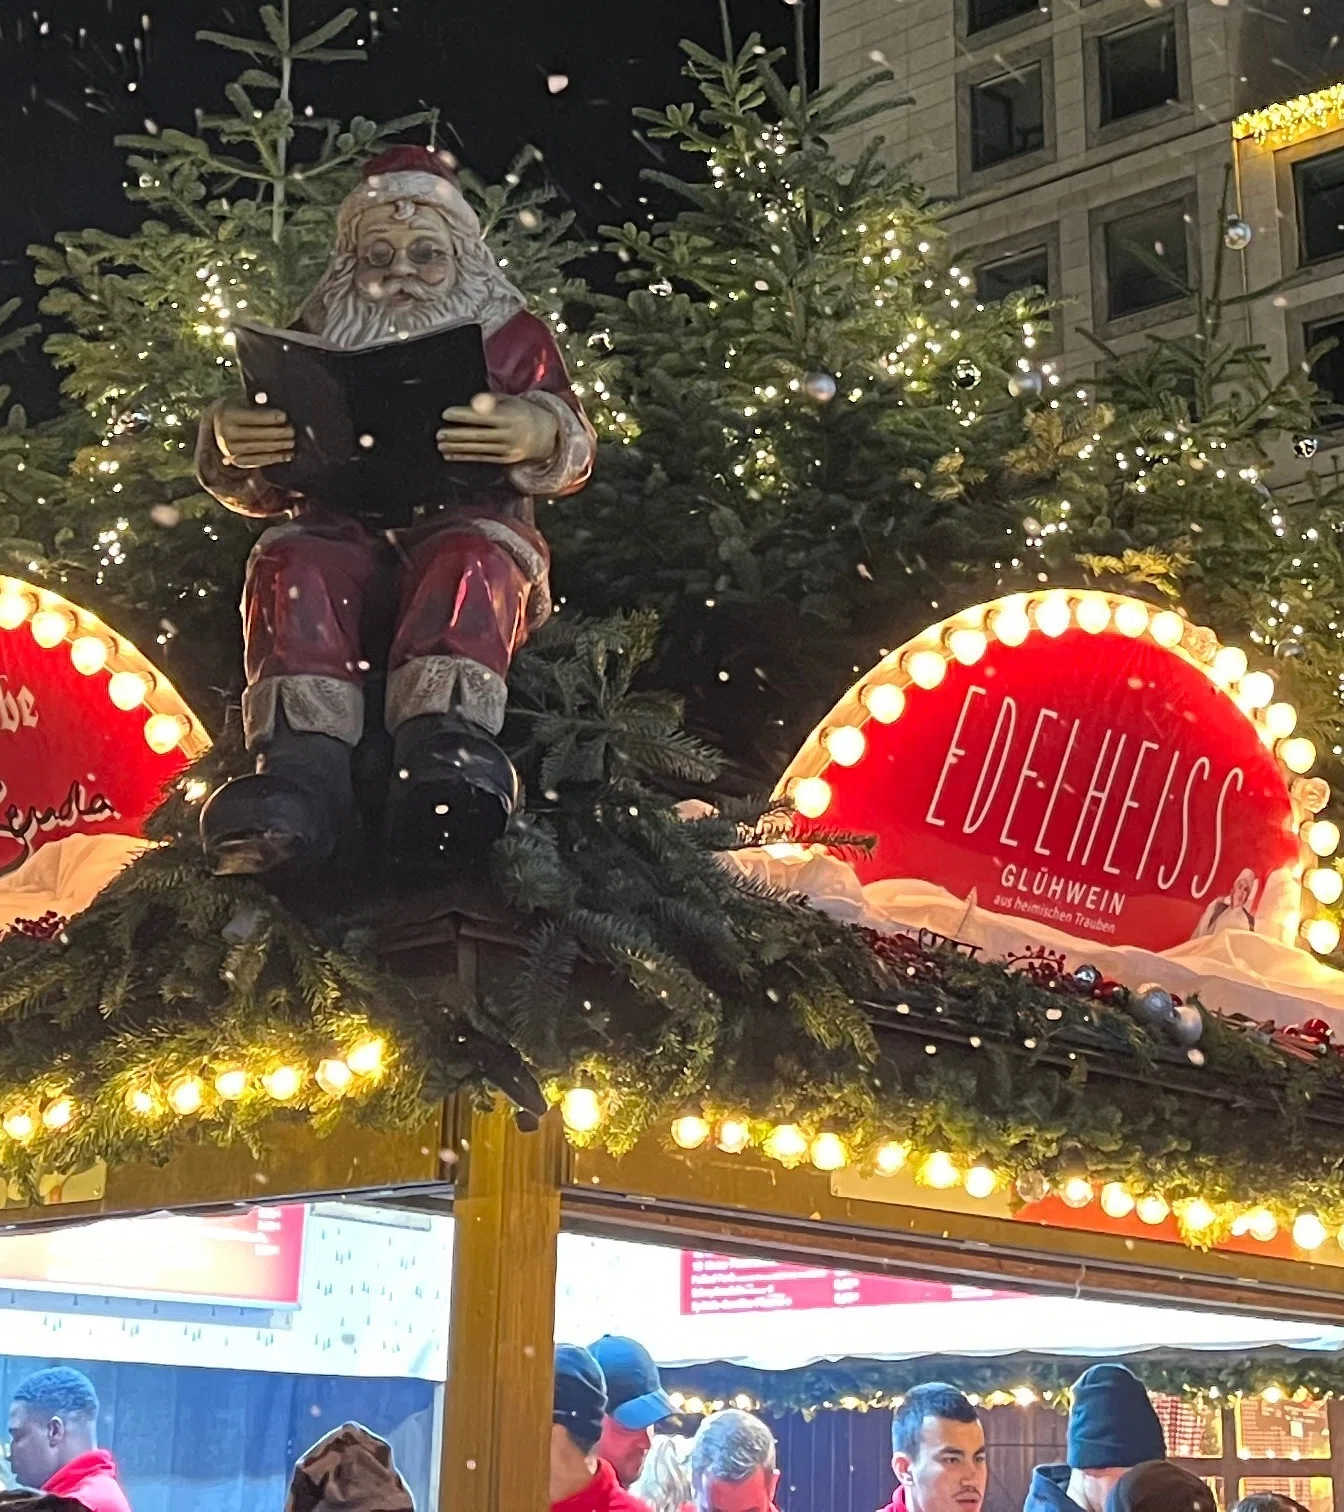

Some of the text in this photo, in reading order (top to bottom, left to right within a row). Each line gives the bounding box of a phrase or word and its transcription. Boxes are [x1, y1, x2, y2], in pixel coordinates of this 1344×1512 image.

[924, 684, 1244, 900] EDELHEISS
[993, 894, 1116, 934] aus heimischen Trauben
[1001, 863, 1126, 916] GLÜHWEIN
